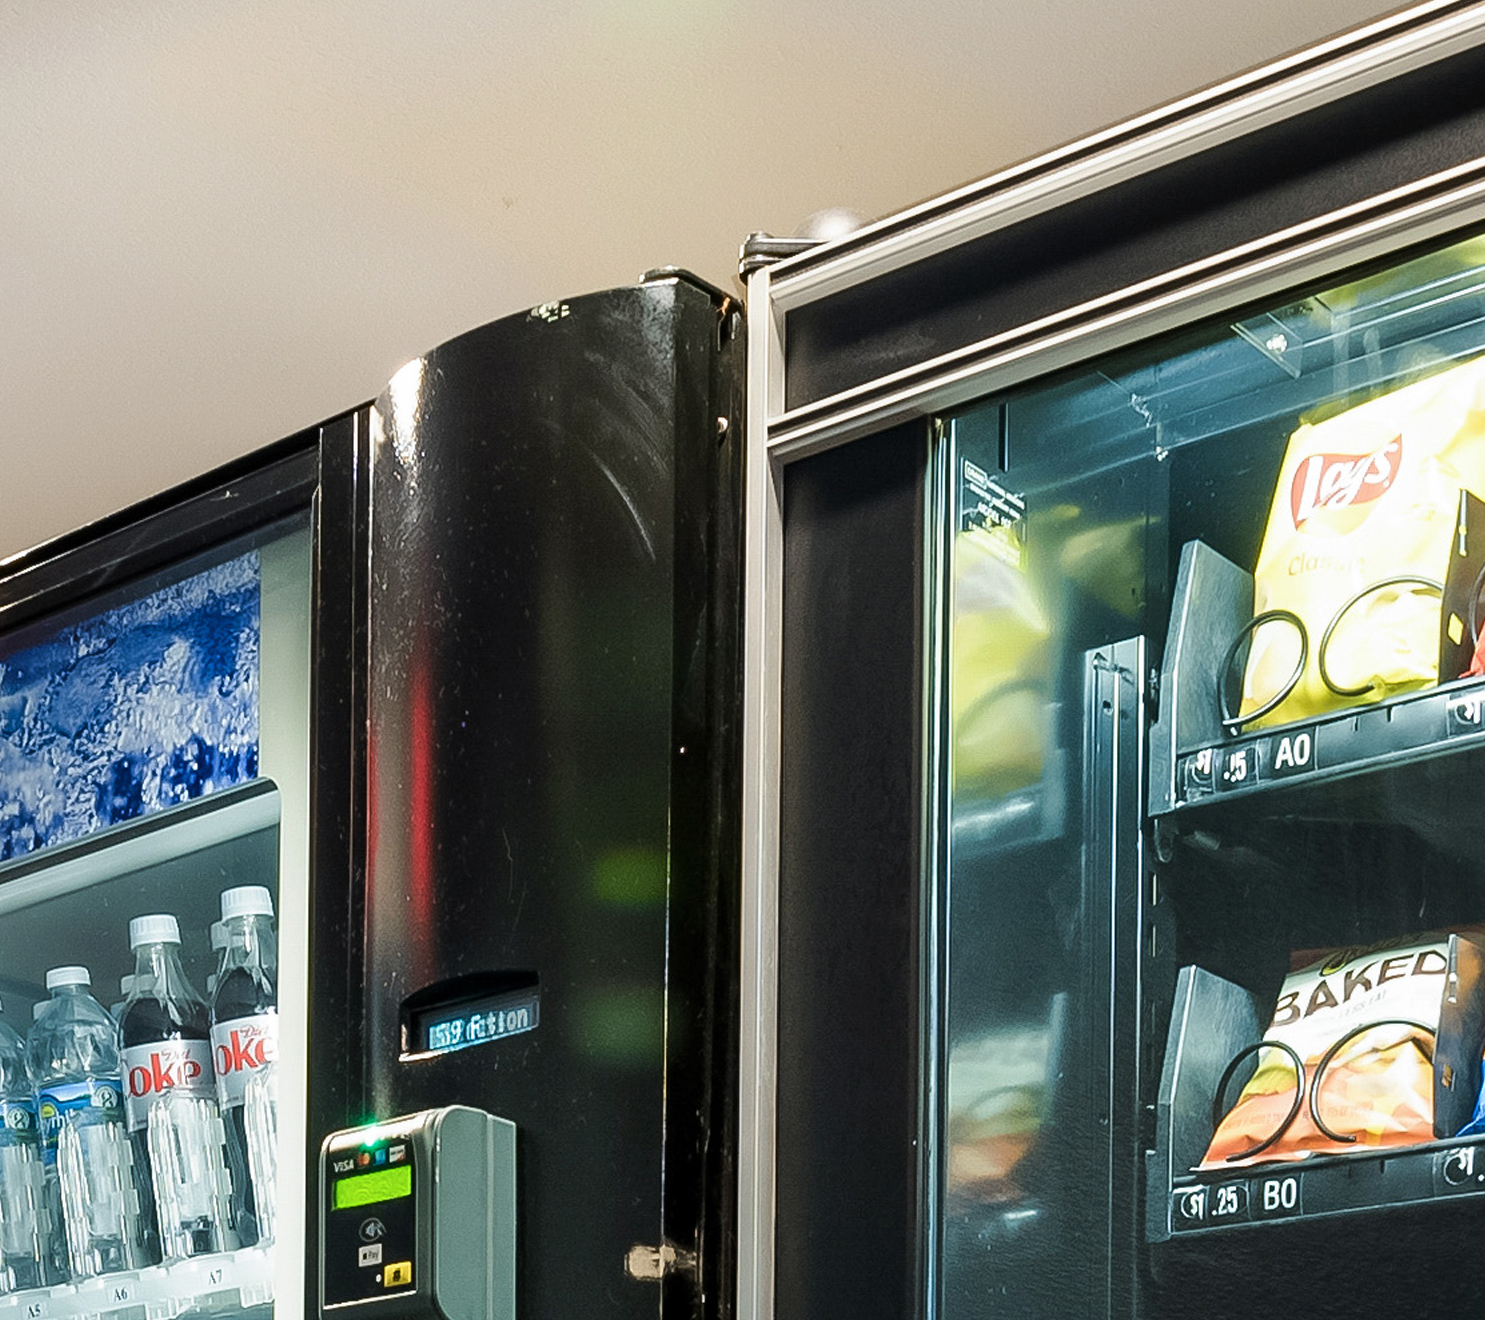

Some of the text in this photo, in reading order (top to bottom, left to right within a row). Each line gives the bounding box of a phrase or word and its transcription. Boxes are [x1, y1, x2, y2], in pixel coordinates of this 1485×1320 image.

[1295, 442, 1399, 528] Lay's
[1274, 733, 1312, 770] A0
[1272, 950, 1446, 1026] BAKED
[129, 1053, 201, 1097] oke
[333, 1159, 355, 1173] VISA
[1263, 1180, 1297, 1210] B0
[27, 1269, 223, 1319] A5 A6 A7
